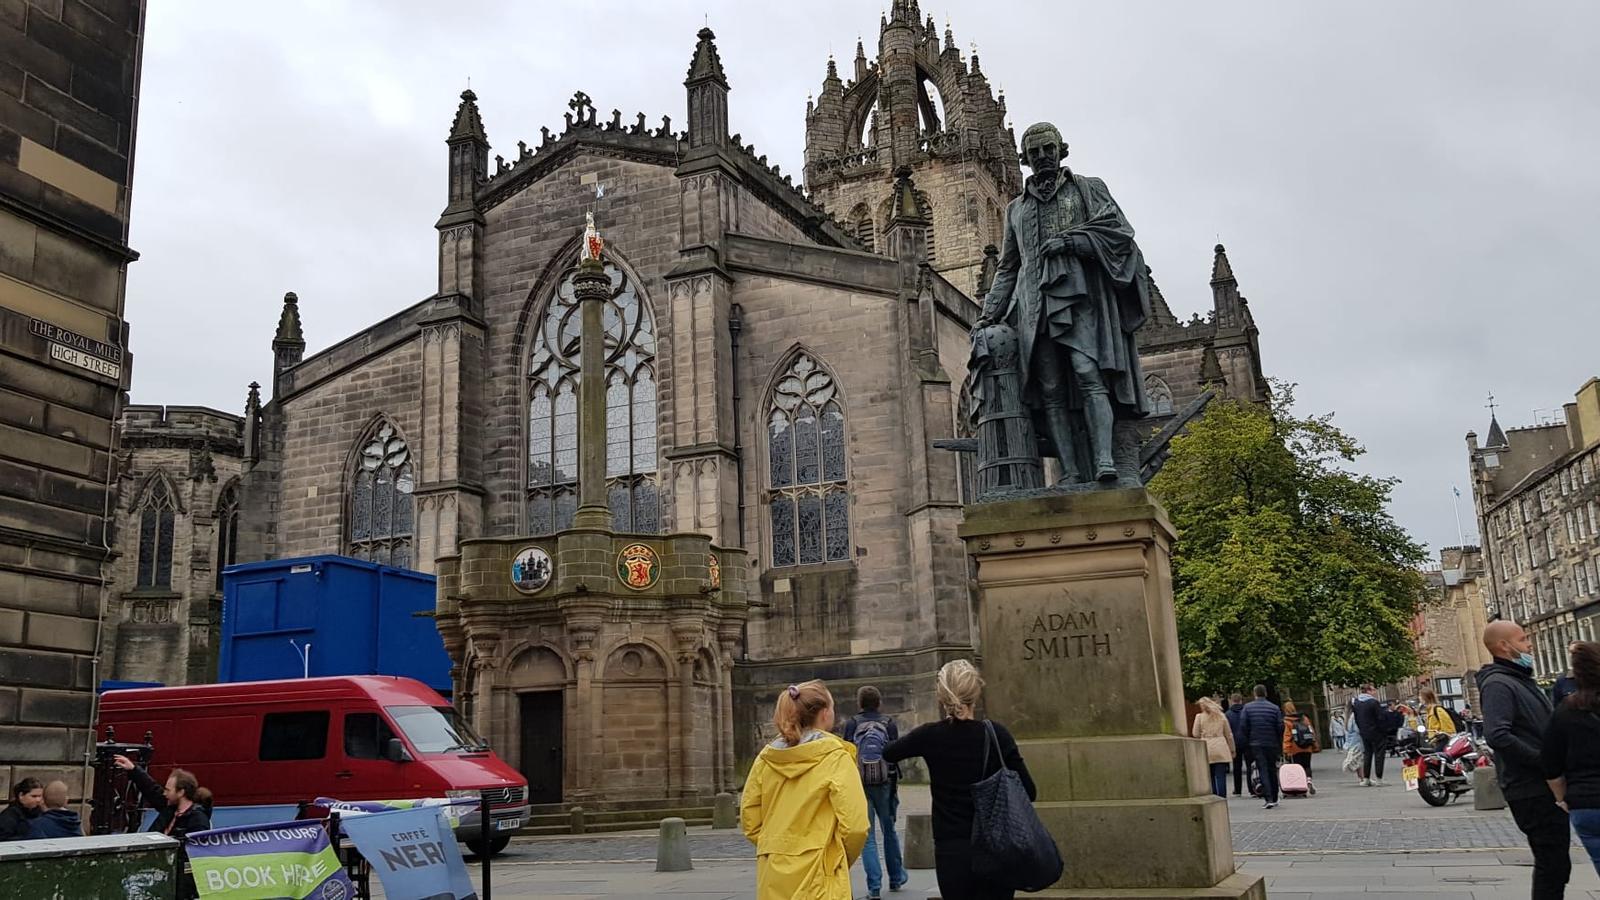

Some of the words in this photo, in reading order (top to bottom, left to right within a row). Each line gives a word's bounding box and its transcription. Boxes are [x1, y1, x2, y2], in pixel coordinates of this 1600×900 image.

[33, 320, 53, 337] THE
[56, 329, 91, 351] ROYAL
[95, 343, 120, 361] MILE
[53, 345, 78, 364] HIGH
[83, 355, 119, 378] STREET
[1032, 611, 1097, 632] ADAM
[1023, 633, 1111, 660] SMITH
[271, 827, 318, 841] TOURS
[391, 828, 429, 842] CAFFÈ
[380, 842, 447, 871] NER
[206, 865, 277, 891] BOOK
